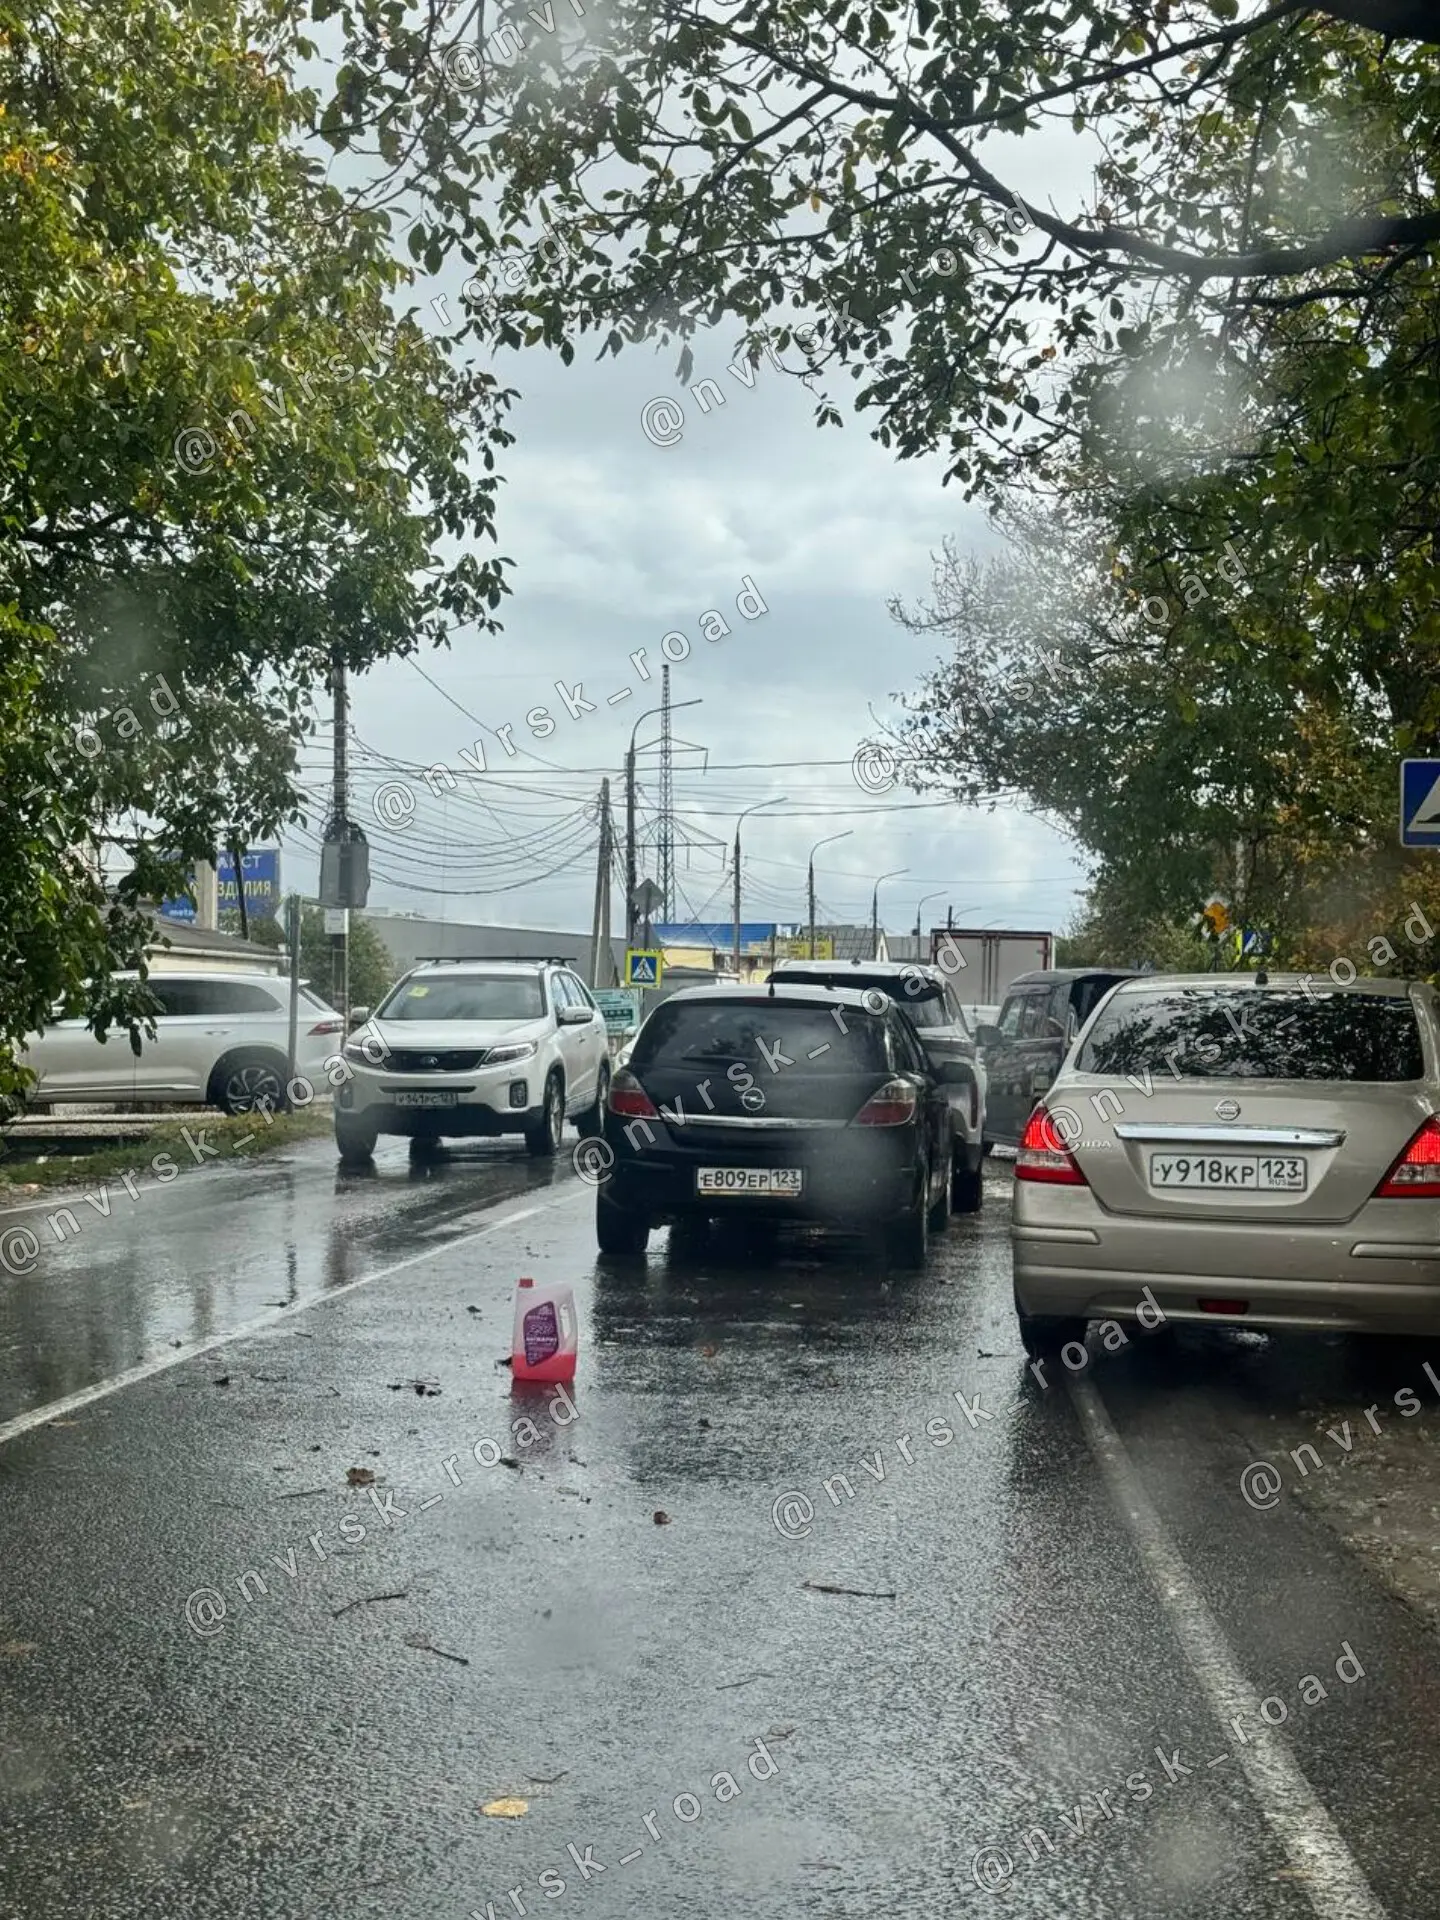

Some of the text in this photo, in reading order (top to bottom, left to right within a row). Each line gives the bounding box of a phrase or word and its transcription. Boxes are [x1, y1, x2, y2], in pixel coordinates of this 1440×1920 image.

[703, 1170, 798, 1188] Е809ЕР 123
[1161, 1159, 1298, 1184] У918КР 123
